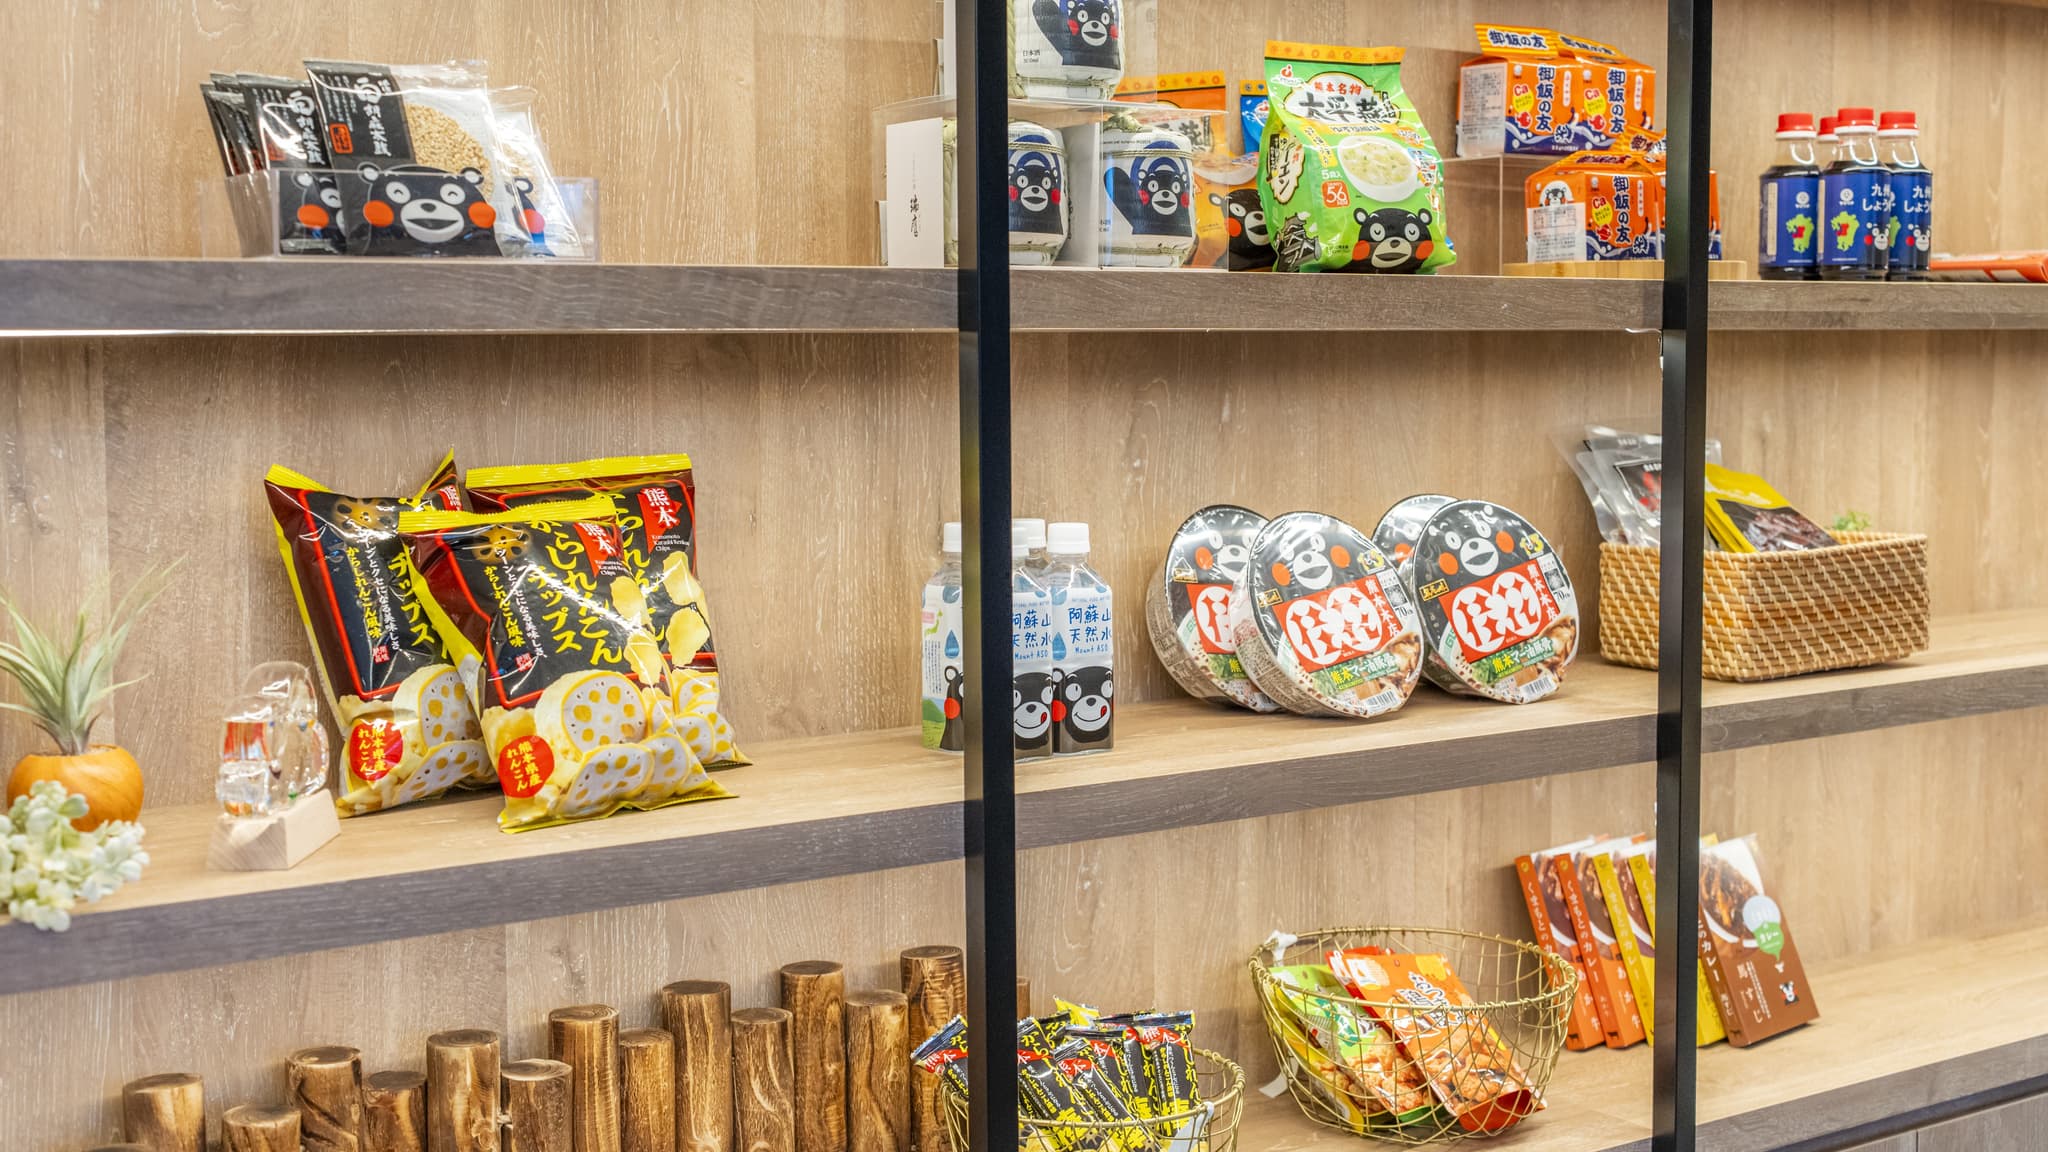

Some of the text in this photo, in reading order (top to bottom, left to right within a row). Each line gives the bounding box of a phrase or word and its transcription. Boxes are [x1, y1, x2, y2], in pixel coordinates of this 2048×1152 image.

[1488, 29, 1547, 50] 御飯の友
[1313, 80, 1363, 96] 熊本名物
[1513, 84, 1530, 97] Ca
[1536, 65, 1555, 133] 御飯の友
[1584, 89, 1601, 101] Ca
[1608, 69, 1626, 134] 御飯の友
[1325, 184, 1348, 204] 56
[1591, 197, 1608, 210] Ca
[1871, 183, 1891, 198] 九州
[1612, 175, 1632, 245] 御飯の友
[643, 487, 679, 528] 熊本
[577, 521, 616, 556] 熊本
[388, 551, 435, 647] チップス
[527, 565, 583, 654] チップス
[1068, 603, 1112, 625] 阿蘇山
[1013, 631, 1051, 649] 天然水
[1069, 626, 1112, 645] 天然水
[506, 748, 529, 792] れんこん
[518, 741, 544, 788] 熊本県産
[1617, 966, 1641, 1030] あか牛
